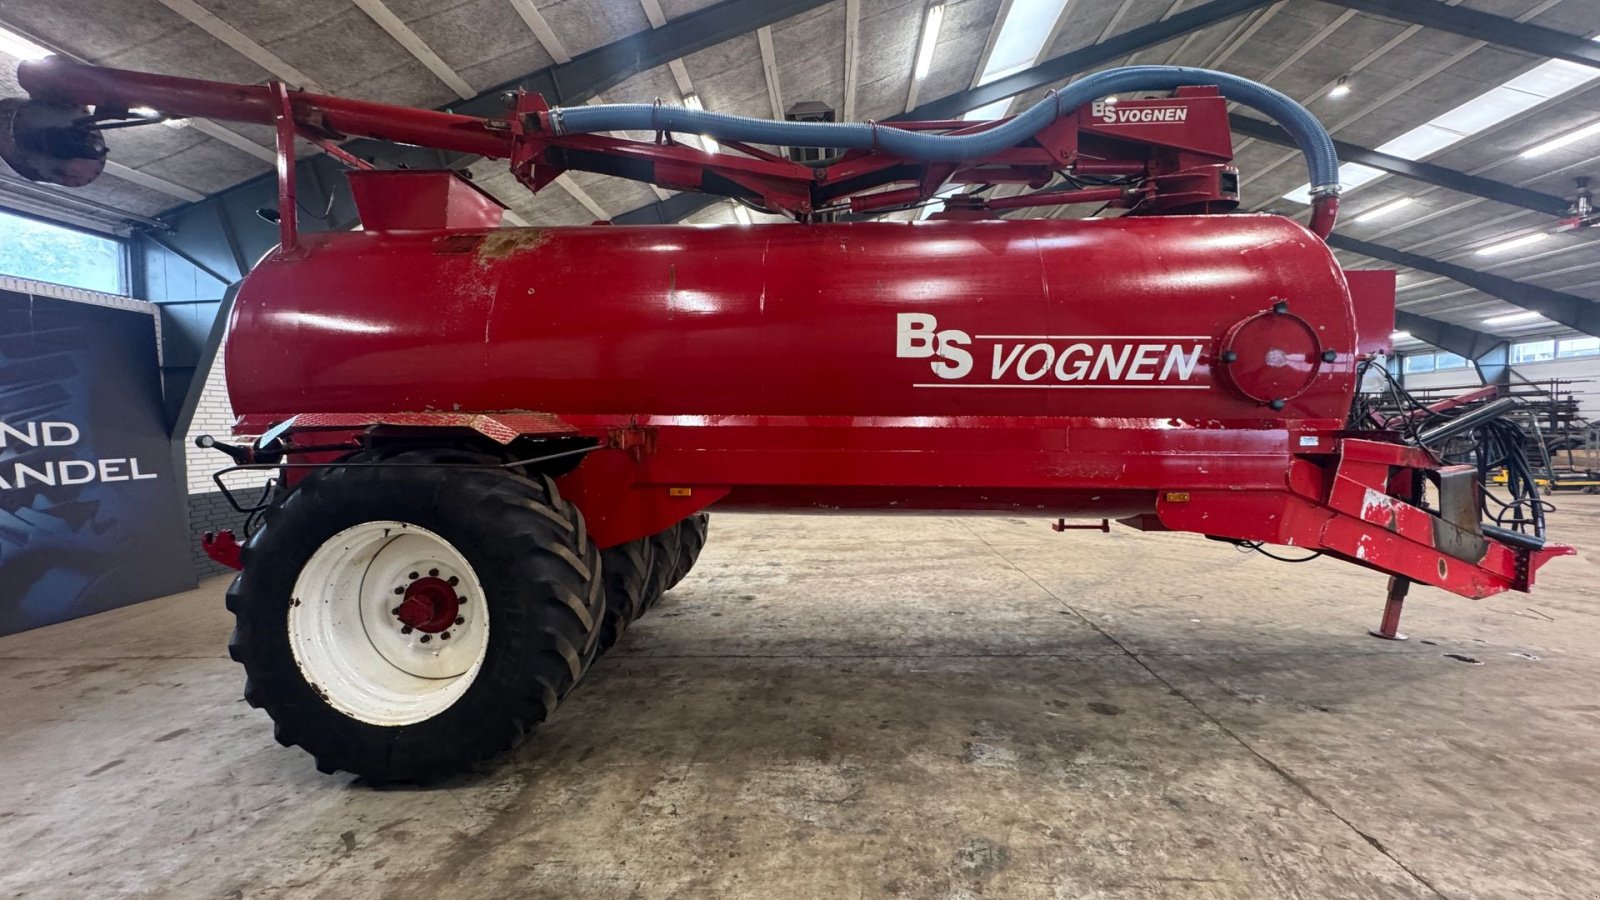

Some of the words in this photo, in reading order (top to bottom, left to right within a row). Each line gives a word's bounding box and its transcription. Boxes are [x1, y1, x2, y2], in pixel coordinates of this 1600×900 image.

[1092, 101, 1117, 123] BS
[1118, 109, 1188, 123] VOGNEN
[896, 312, 974, 380] BS
[991, 343, 1203, 381] VOGNEN
